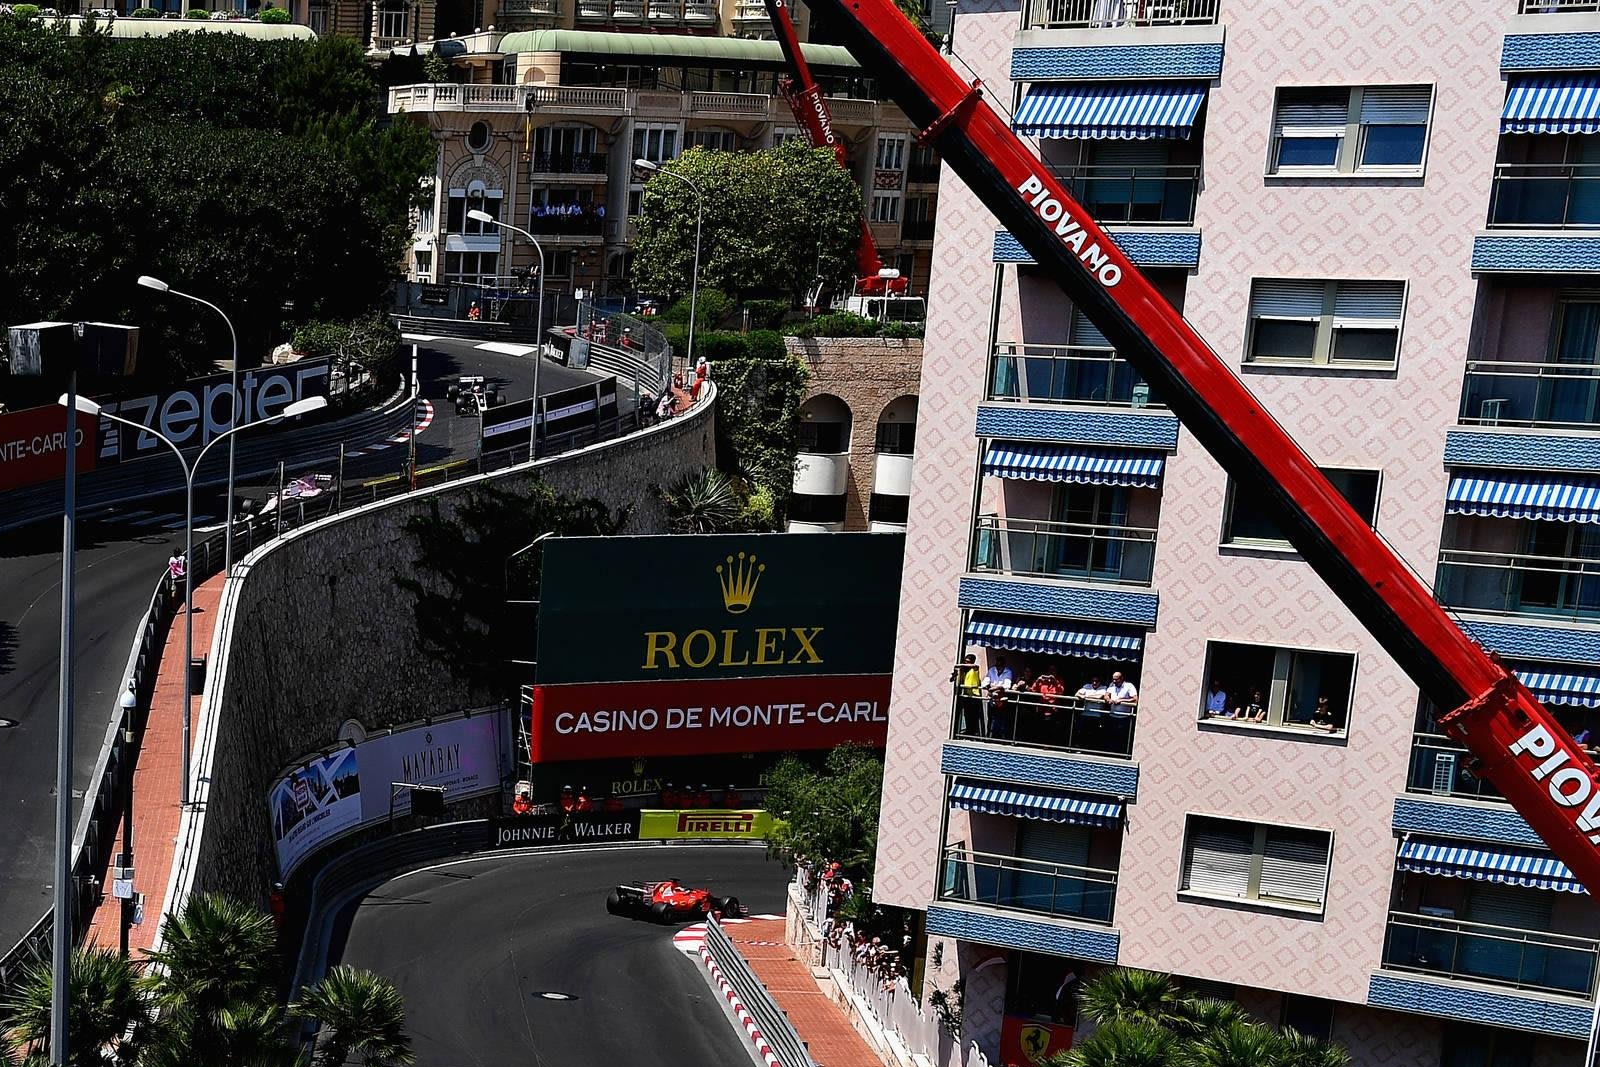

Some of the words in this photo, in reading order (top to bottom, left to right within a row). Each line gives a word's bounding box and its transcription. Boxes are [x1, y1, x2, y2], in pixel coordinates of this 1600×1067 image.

[811, 91, 835, 144] PIOVANO
[1017, 174, 1122, 287] PIOVANO
[120, 364, 329, 450] zepter
[640, 627, 824, 669] ROLEX
[555, 708, 659, 734] CASINO
[666, 707, 703, 729] DE
[709, 701, 889, 728] MONTE-CARL
[402, 743, 461, 783] MAYABAY
[611, 777, 663, 794] ROLEX
[1508, 722, 1600, 846] PIOV
[496, 825, 556, 846] JOHNNIE
[574, 822, 632, 837] WALKER
[677, 813, 754, 833] PIRELLI
